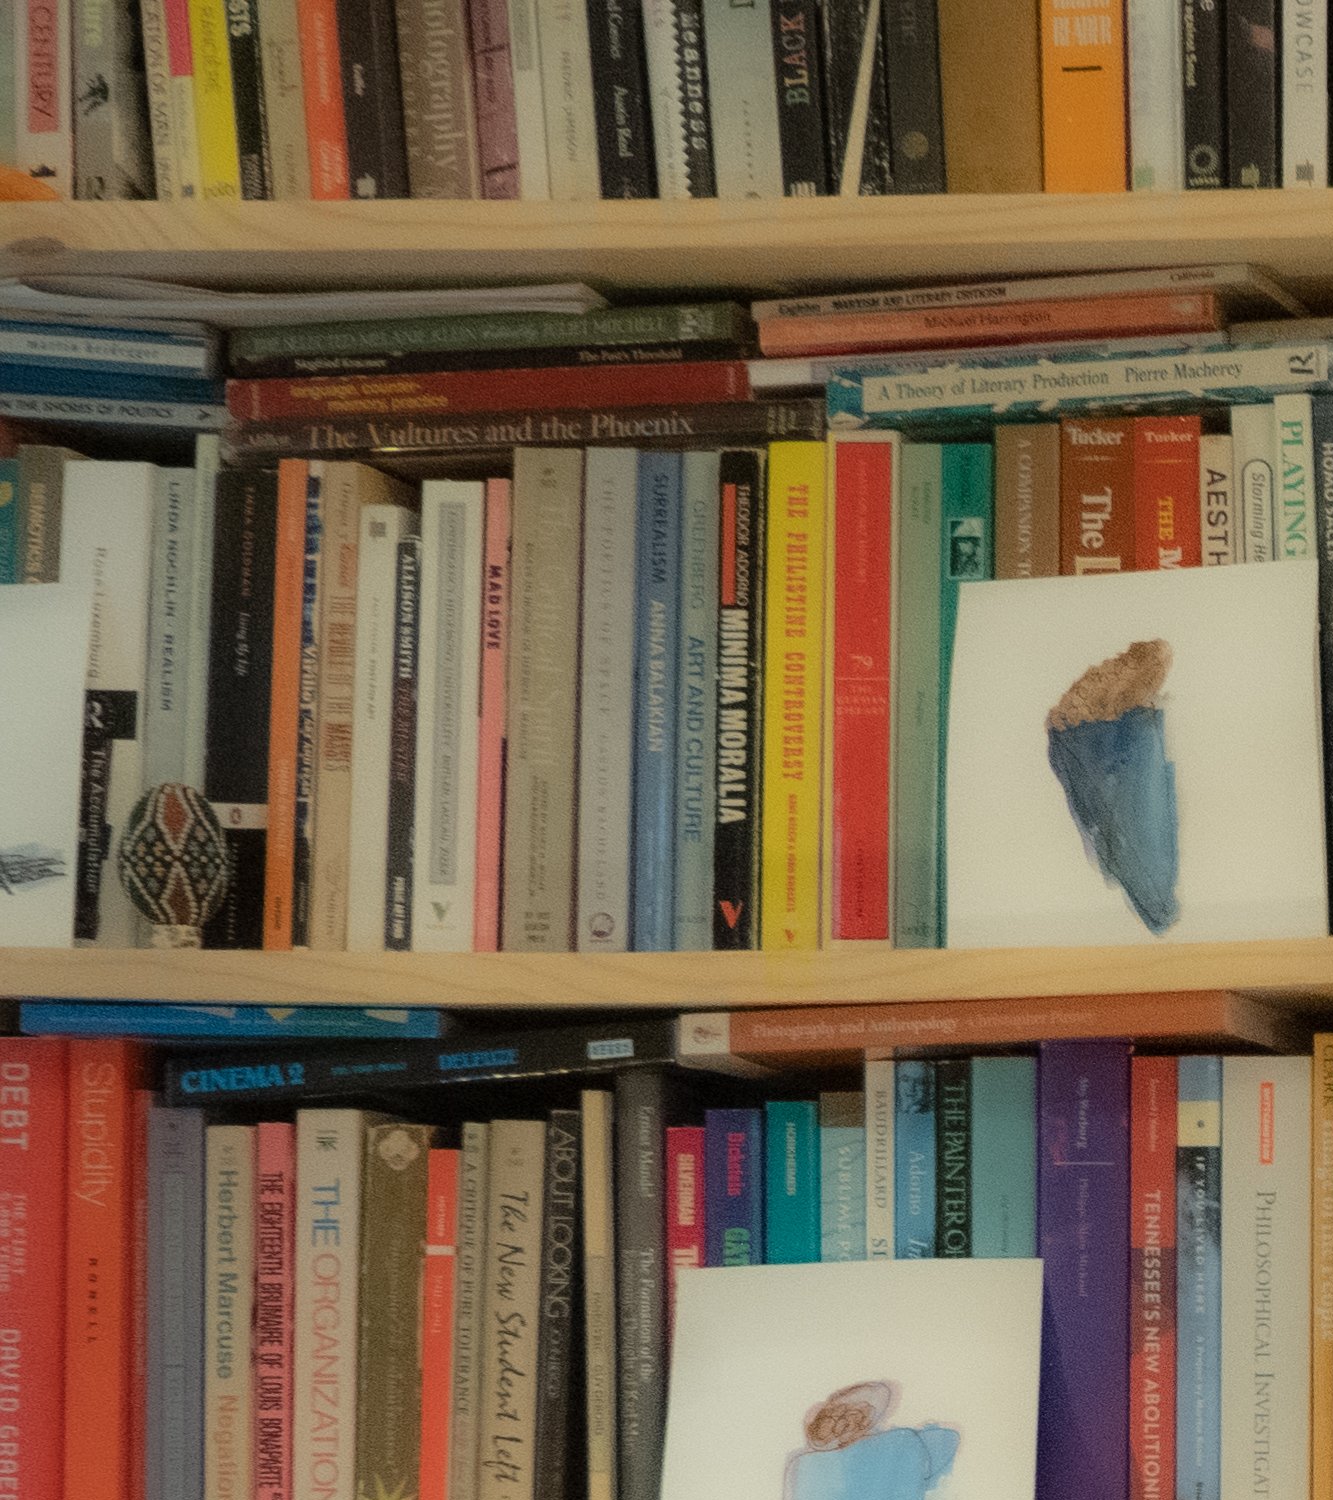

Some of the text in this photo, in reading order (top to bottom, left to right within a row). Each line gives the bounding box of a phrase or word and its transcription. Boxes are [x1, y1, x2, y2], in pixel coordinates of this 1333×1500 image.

[781, 14, 811, 105] BLACK
[302, 410, 695, 449] The Vultures and the Phoenix
[879, 361, 1243, 400] A Theory of Literary Production Pierre Macherey
[647, 473, 668, 752] SURREALISM ANNA BALAKIAN
[736, 550, 749, 606] ADORNO
[782, 484, 808, 781] THE PHILISTINE CONTROVERSY
[682, 636, 704, 842] ART AND CULTURE
[718, 709, 745, 823] MORALIA
[180, 1062, 305, 1094] CINEMA 2
[74, 1061, 115, 1207] Stupidity
[217, 1170, 238, 1264] Herbert
[312, 1178, 340, 1246] THE
[216, 1273, 238, 1380] Marcuse
[485, 1190, 529, 1484] The New Student Left
